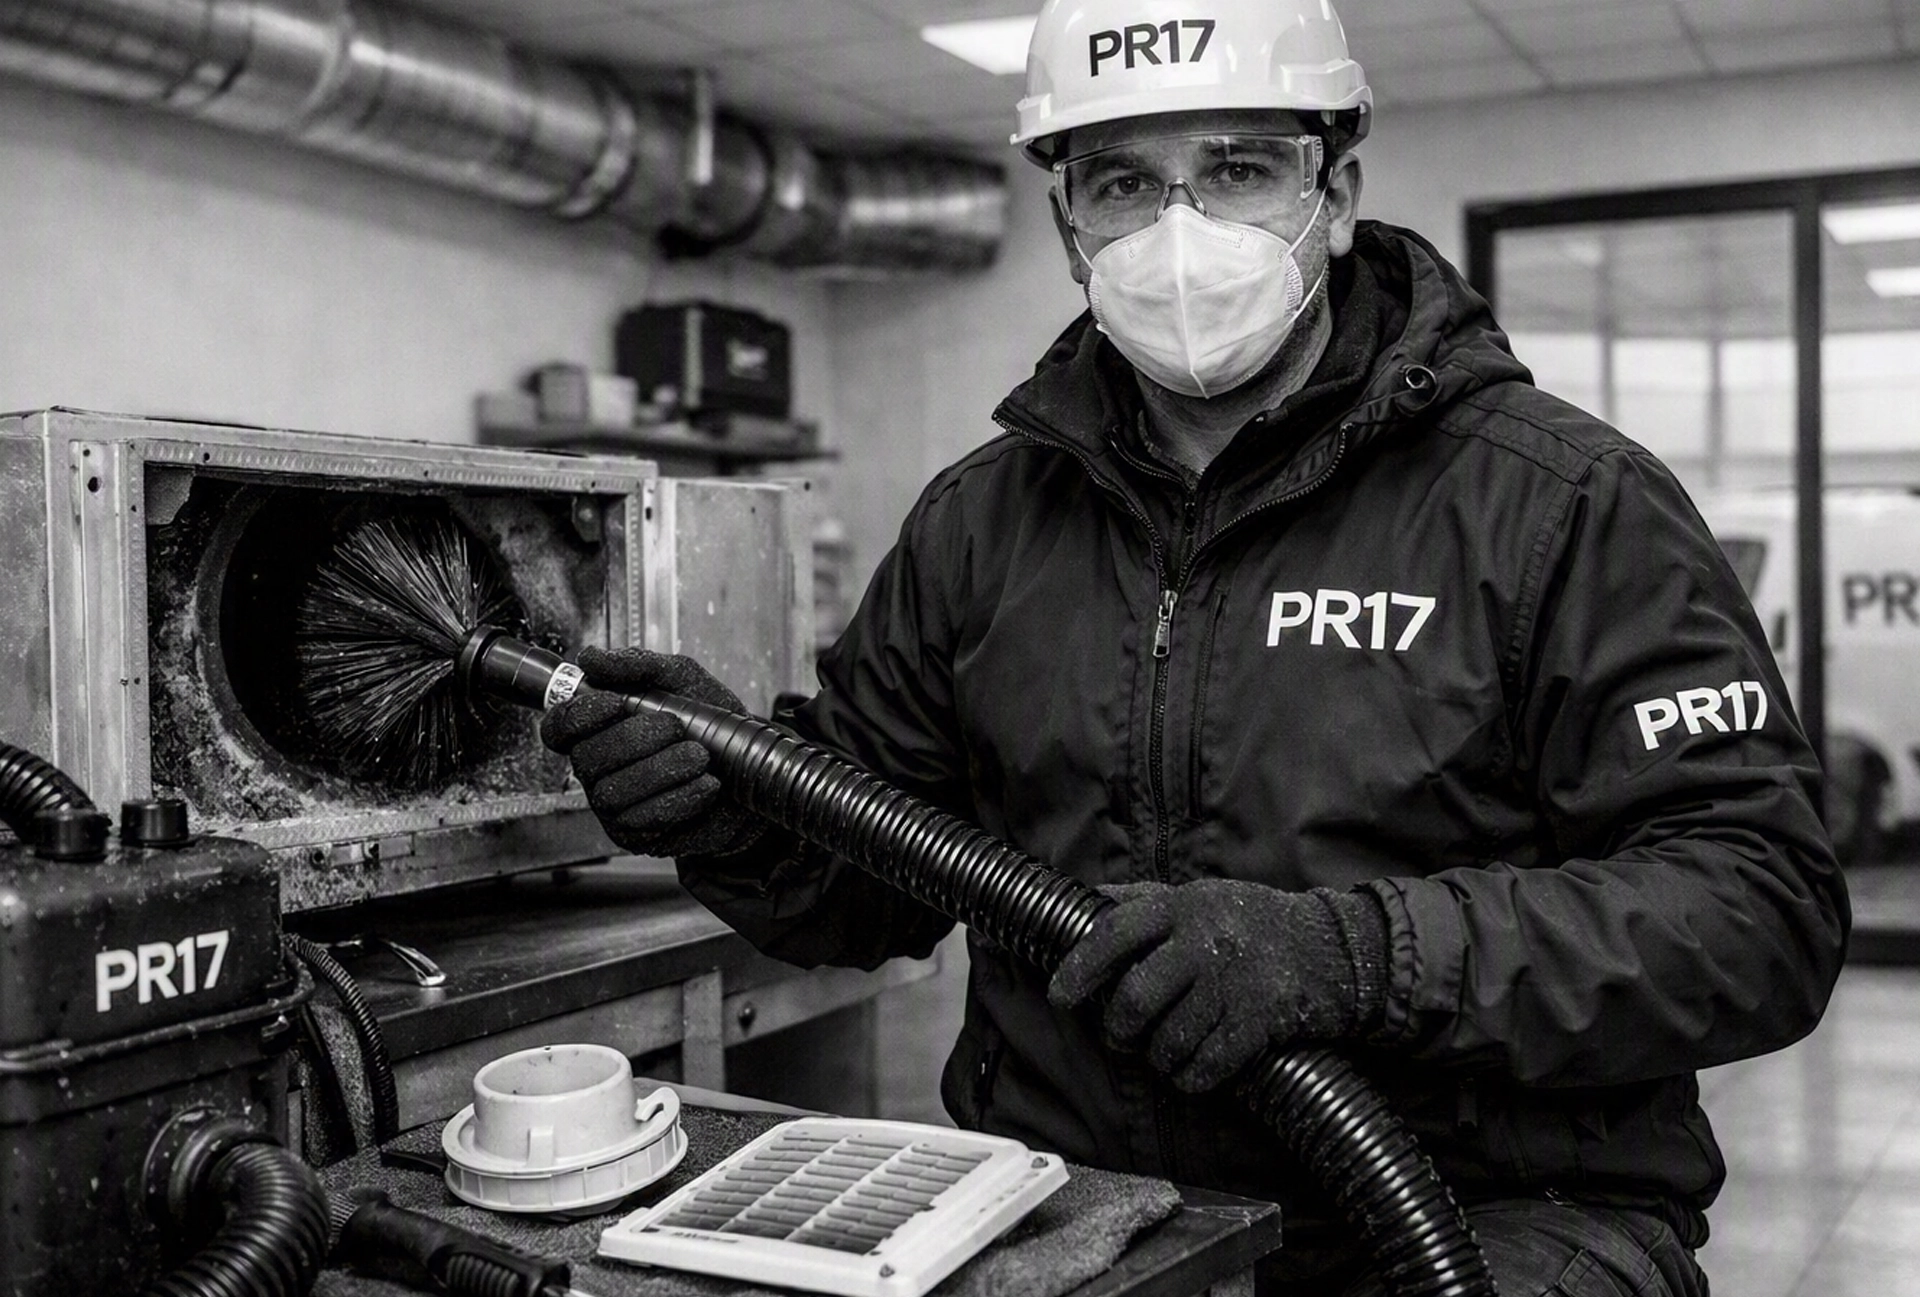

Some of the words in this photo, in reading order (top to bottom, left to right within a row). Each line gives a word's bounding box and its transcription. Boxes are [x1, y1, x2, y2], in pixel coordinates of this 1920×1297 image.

[1089, 19, 1215, 77] PR17
[1266, 589, 1436, 651] PR17
[1633, 680, 1768, 751] PR17
[95, 930, 229, 1012] PR17
